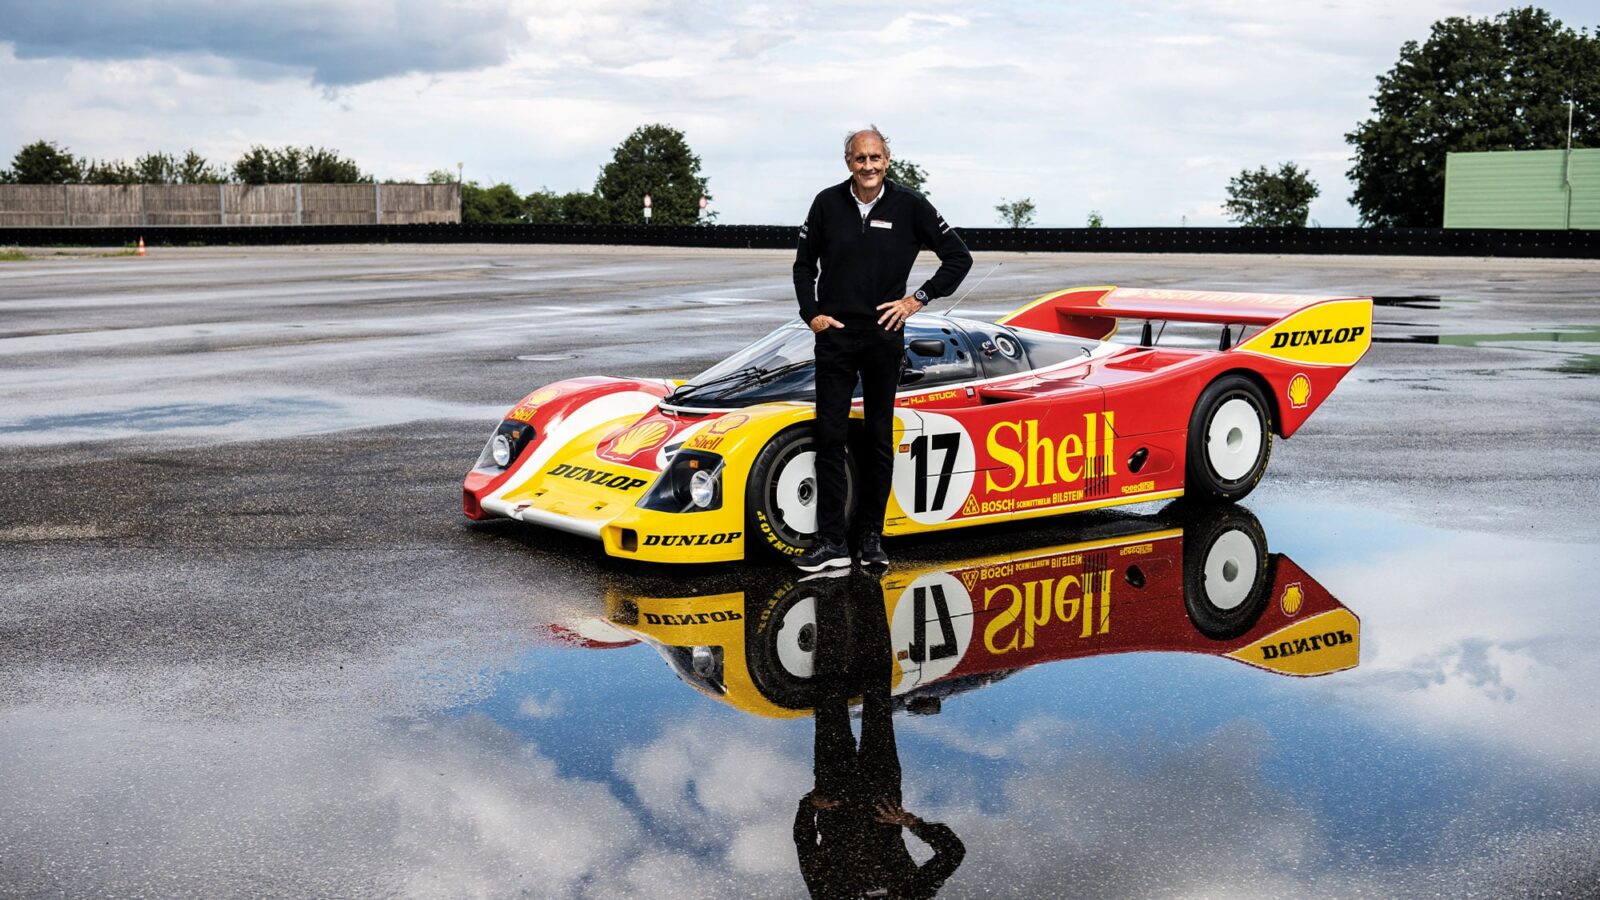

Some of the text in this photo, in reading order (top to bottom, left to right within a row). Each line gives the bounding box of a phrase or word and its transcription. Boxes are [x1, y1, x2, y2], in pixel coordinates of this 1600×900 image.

[1270, 326, 1365, 349] DUNLOP
[928, 391, 957, 402] STUCK
[508, 405, 538, 422] Shell
[687, 434, 725, 451] Shell
[986, 411, 1117, 495] Shell
[547, 463, 648, 491] DUNLOP
[910, 432, 961, 514] 17
[981, 499, 1015, 513] BOSCH
[1052, 489, 1084, 504] BILSTEIN
[642, 531, 743, 547] DUNLOP
